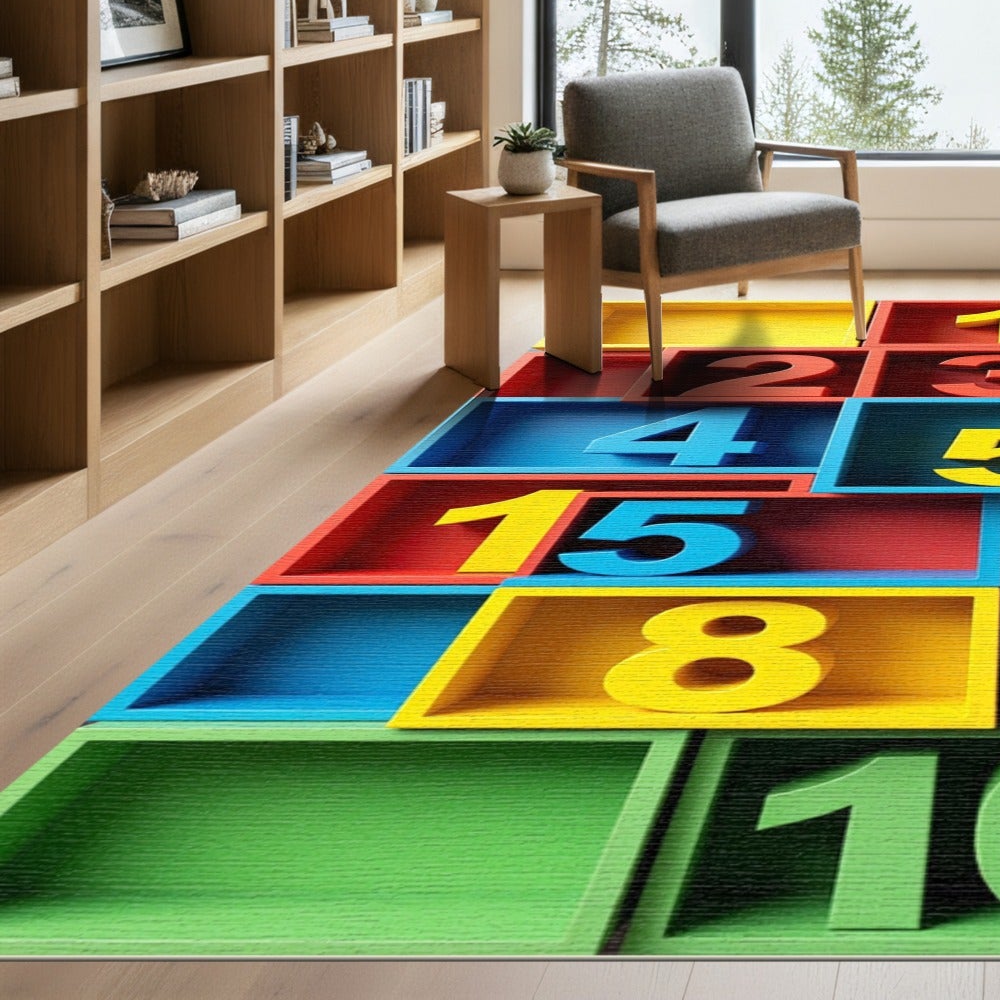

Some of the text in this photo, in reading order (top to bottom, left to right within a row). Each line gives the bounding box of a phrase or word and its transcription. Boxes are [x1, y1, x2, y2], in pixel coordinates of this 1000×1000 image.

[681, 355, 838, 397] 2
[584, 407, 756, 466] 4
[603, 600, 828, 714] 8
